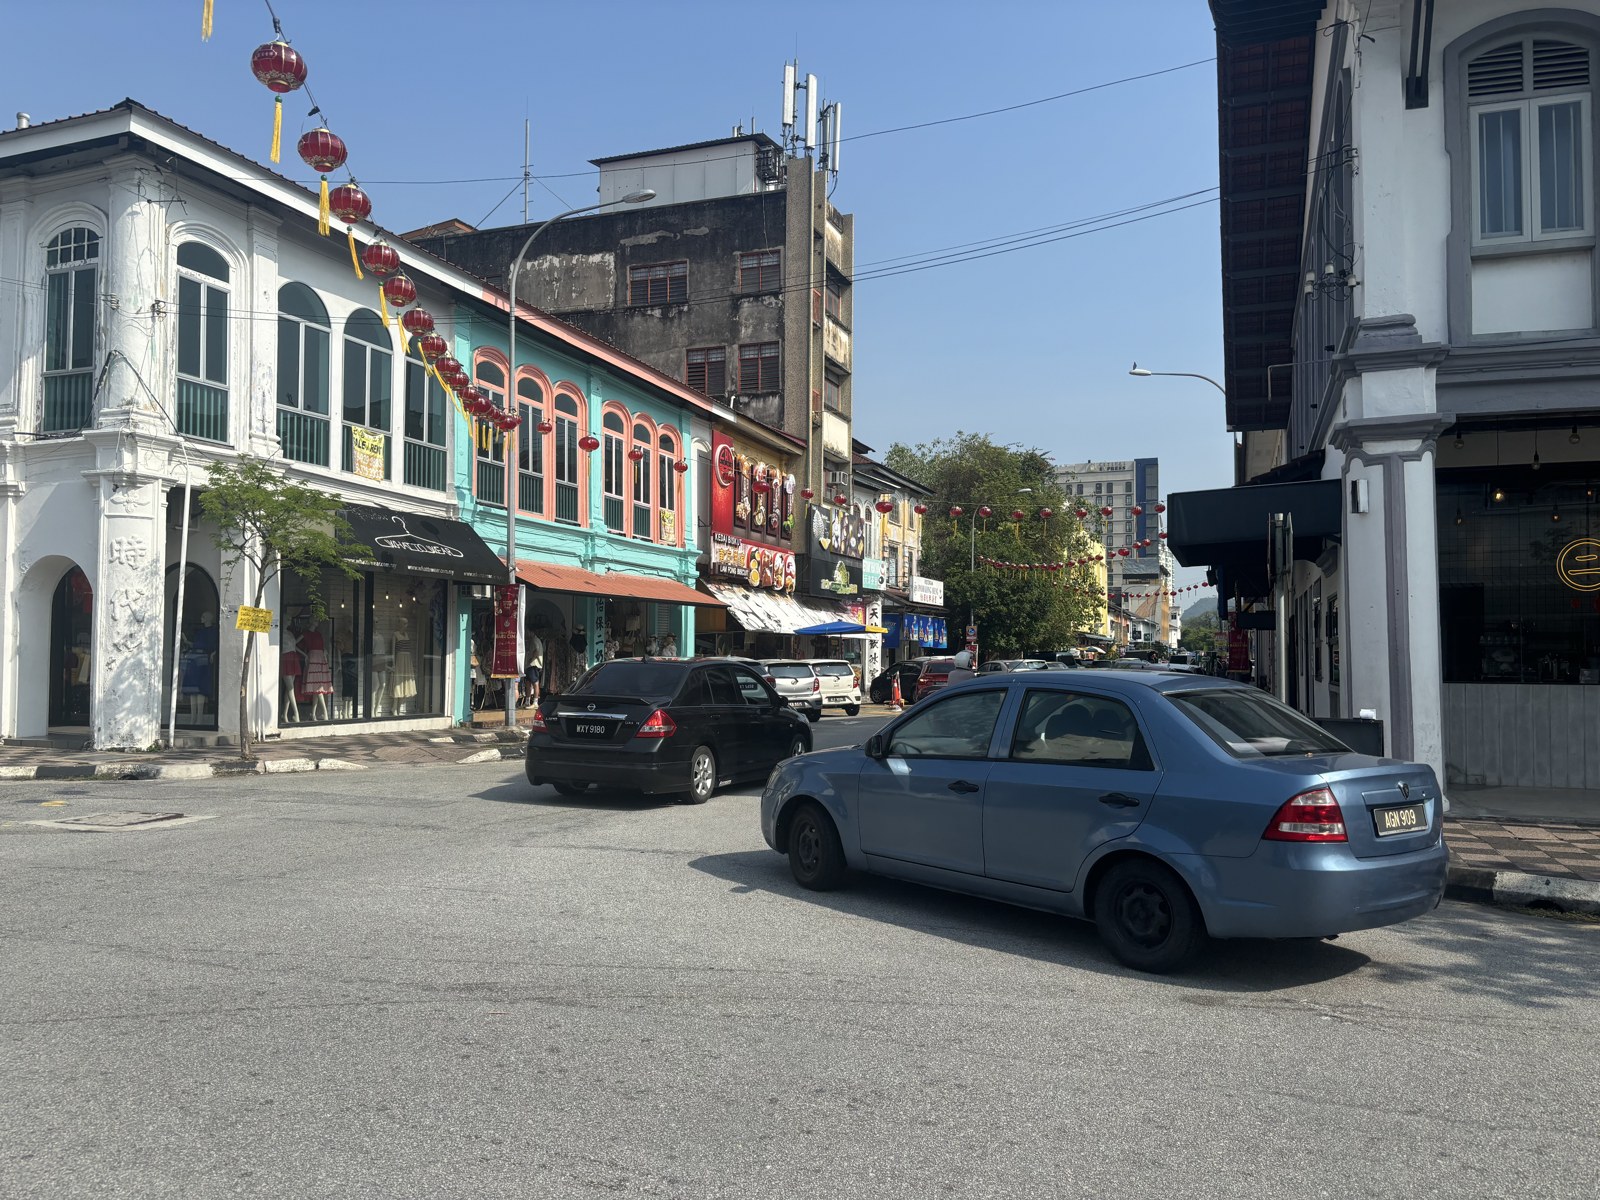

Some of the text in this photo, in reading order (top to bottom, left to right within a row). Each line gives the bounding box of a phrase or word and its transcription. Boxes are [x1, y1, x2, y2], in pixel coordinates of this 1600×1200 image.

[426, 545, 452, 556] WEAR
[576, 724, 605, 734] WXY 9180
[1385, 809, 1416, 828] AGN 909
